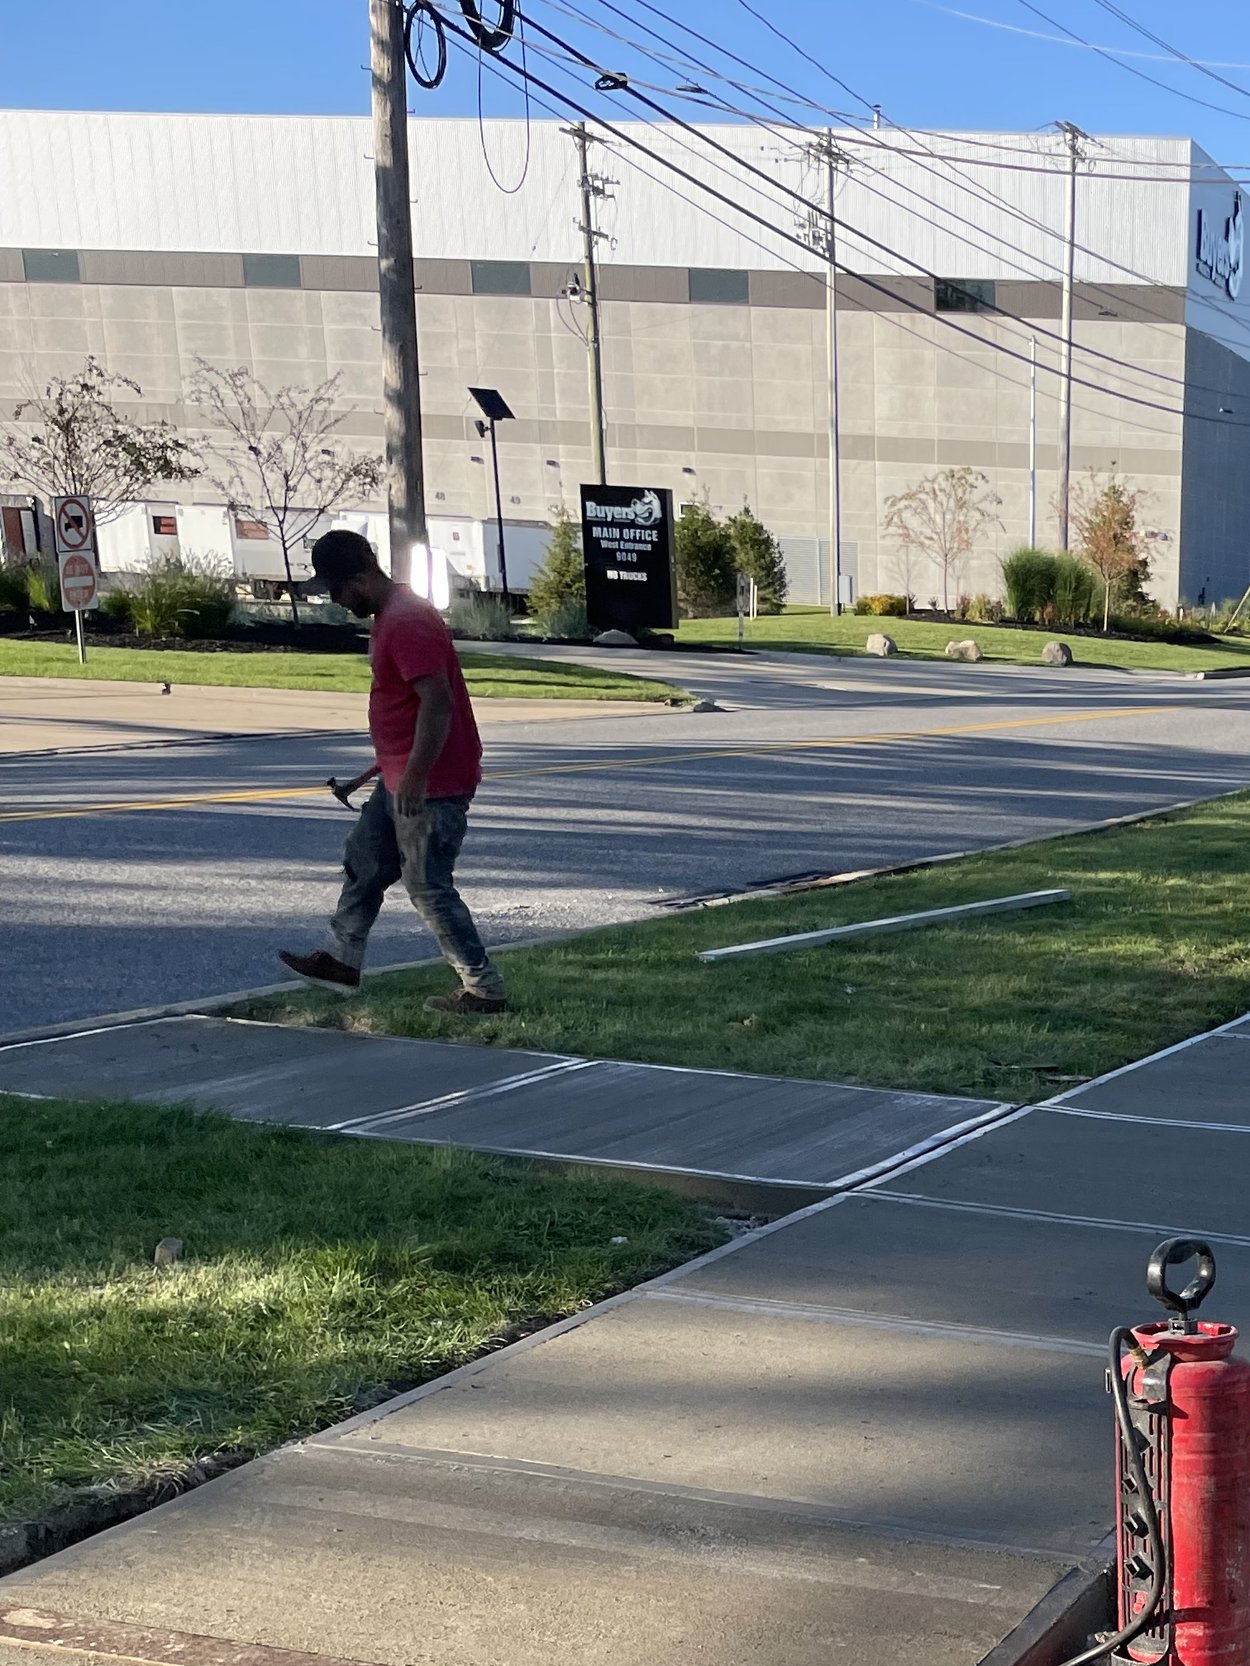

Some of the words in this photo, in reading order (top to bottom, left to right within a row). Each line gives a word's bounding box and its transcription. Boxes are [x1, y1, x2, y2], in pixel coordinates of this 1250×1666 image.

[585, 501, 636, 522] Buyers
[592, 526, 620, 538] MAIN
[622, 528, 658, 541] OFFICE
[600, 539, 619, 549] West
[616, 551, 637, 562] 9049
